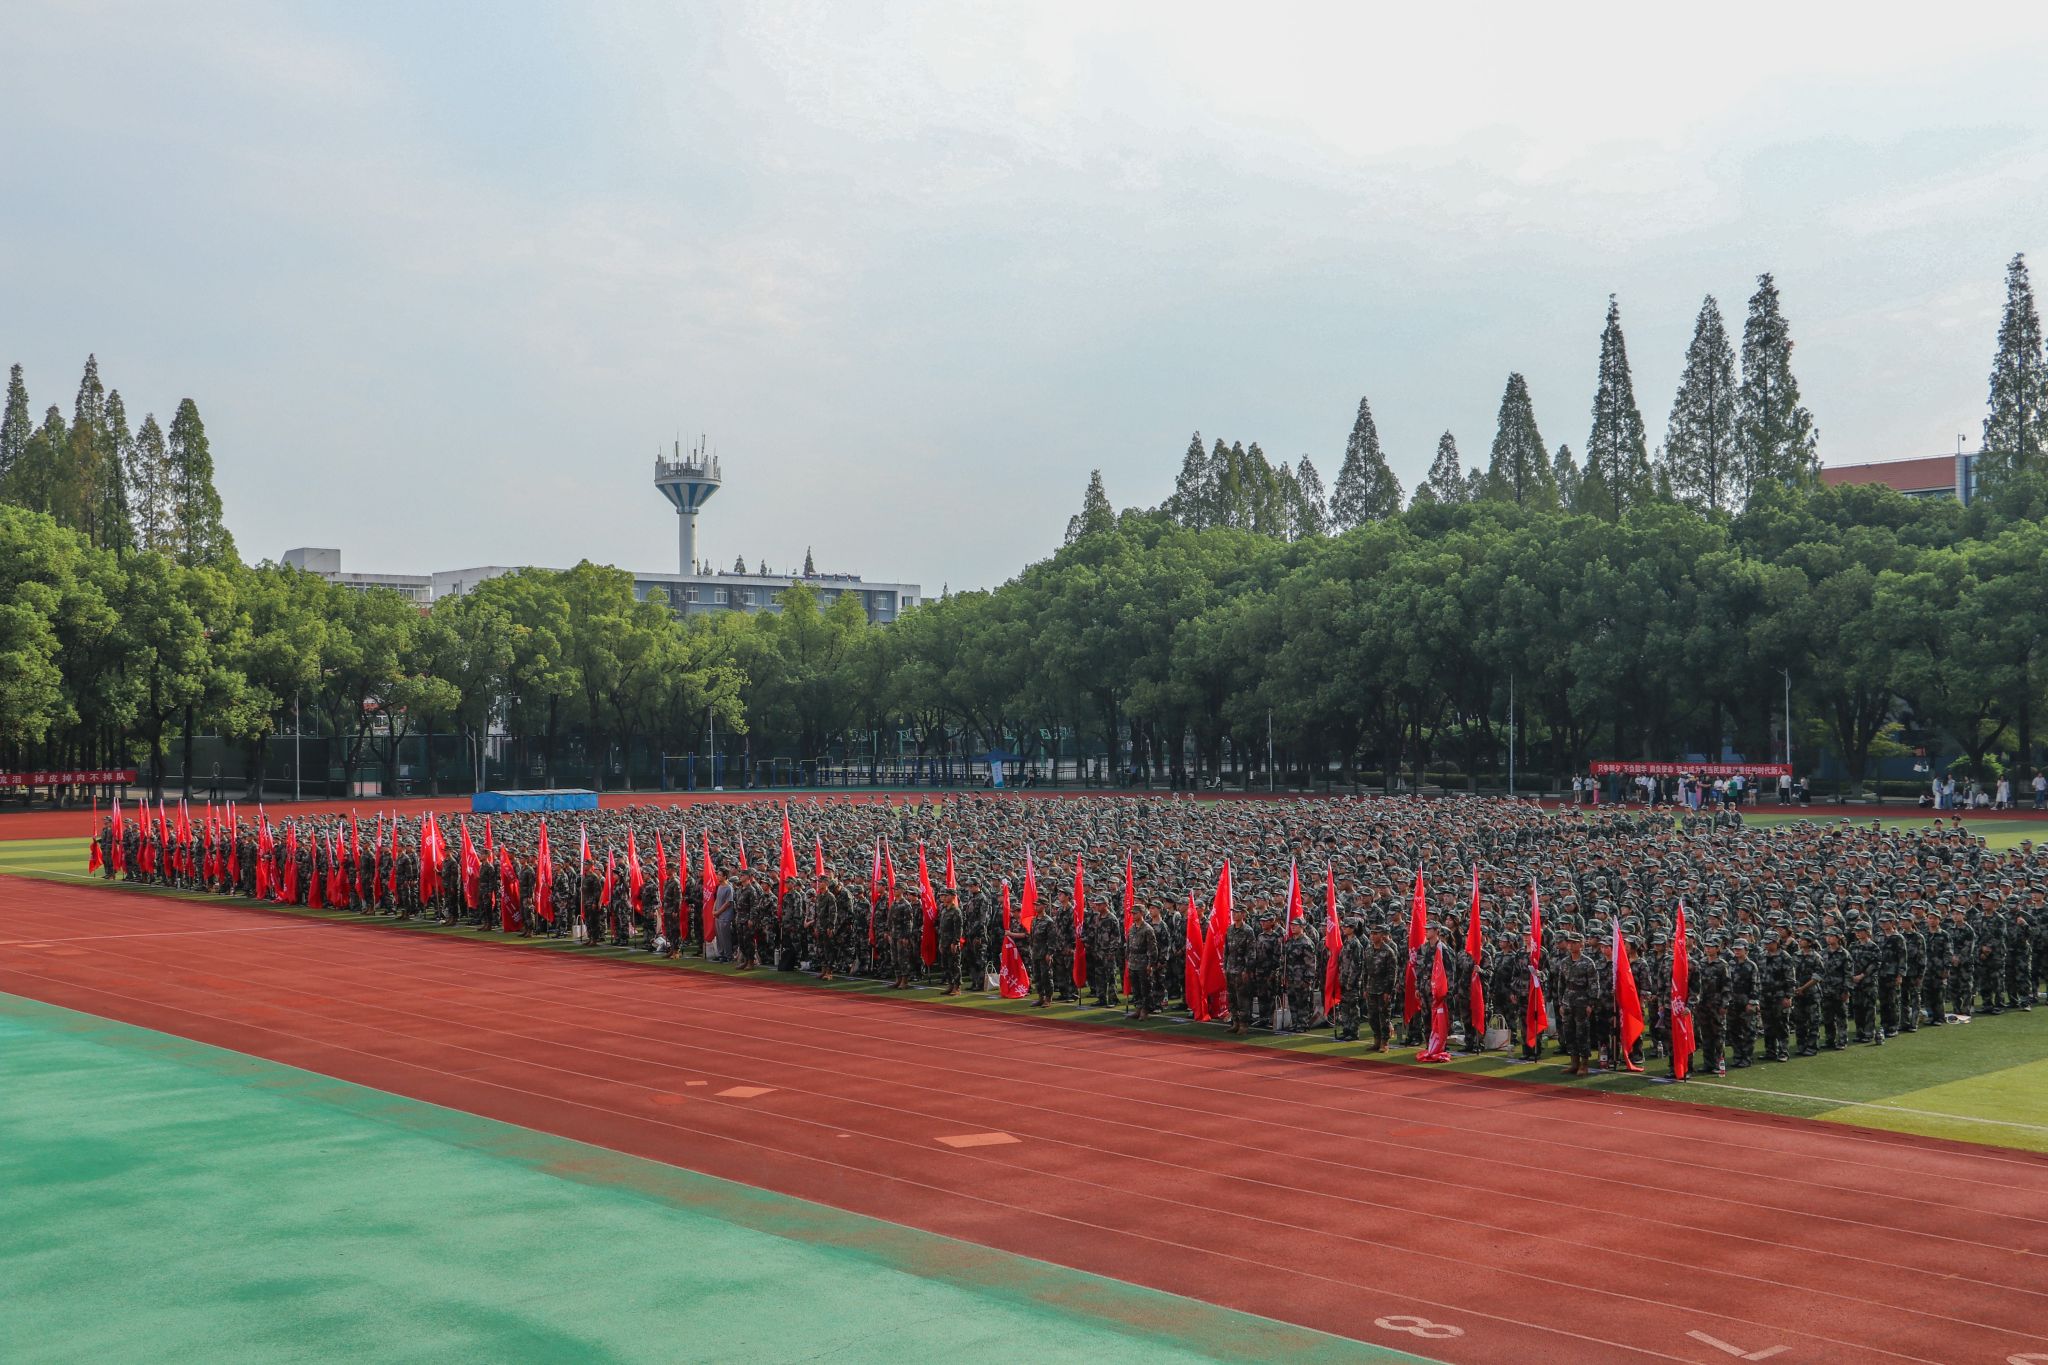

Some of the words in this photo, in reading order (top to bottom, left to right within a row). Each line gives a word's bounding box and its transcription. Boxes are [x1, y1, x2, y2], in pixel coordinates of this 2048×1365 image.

[1598, 764, 1621, 773] 只争朝夕
[35, 772, 126, 783] 掉皮掉肉不掉队
[1374, 1315, 1465, 1339] 8
